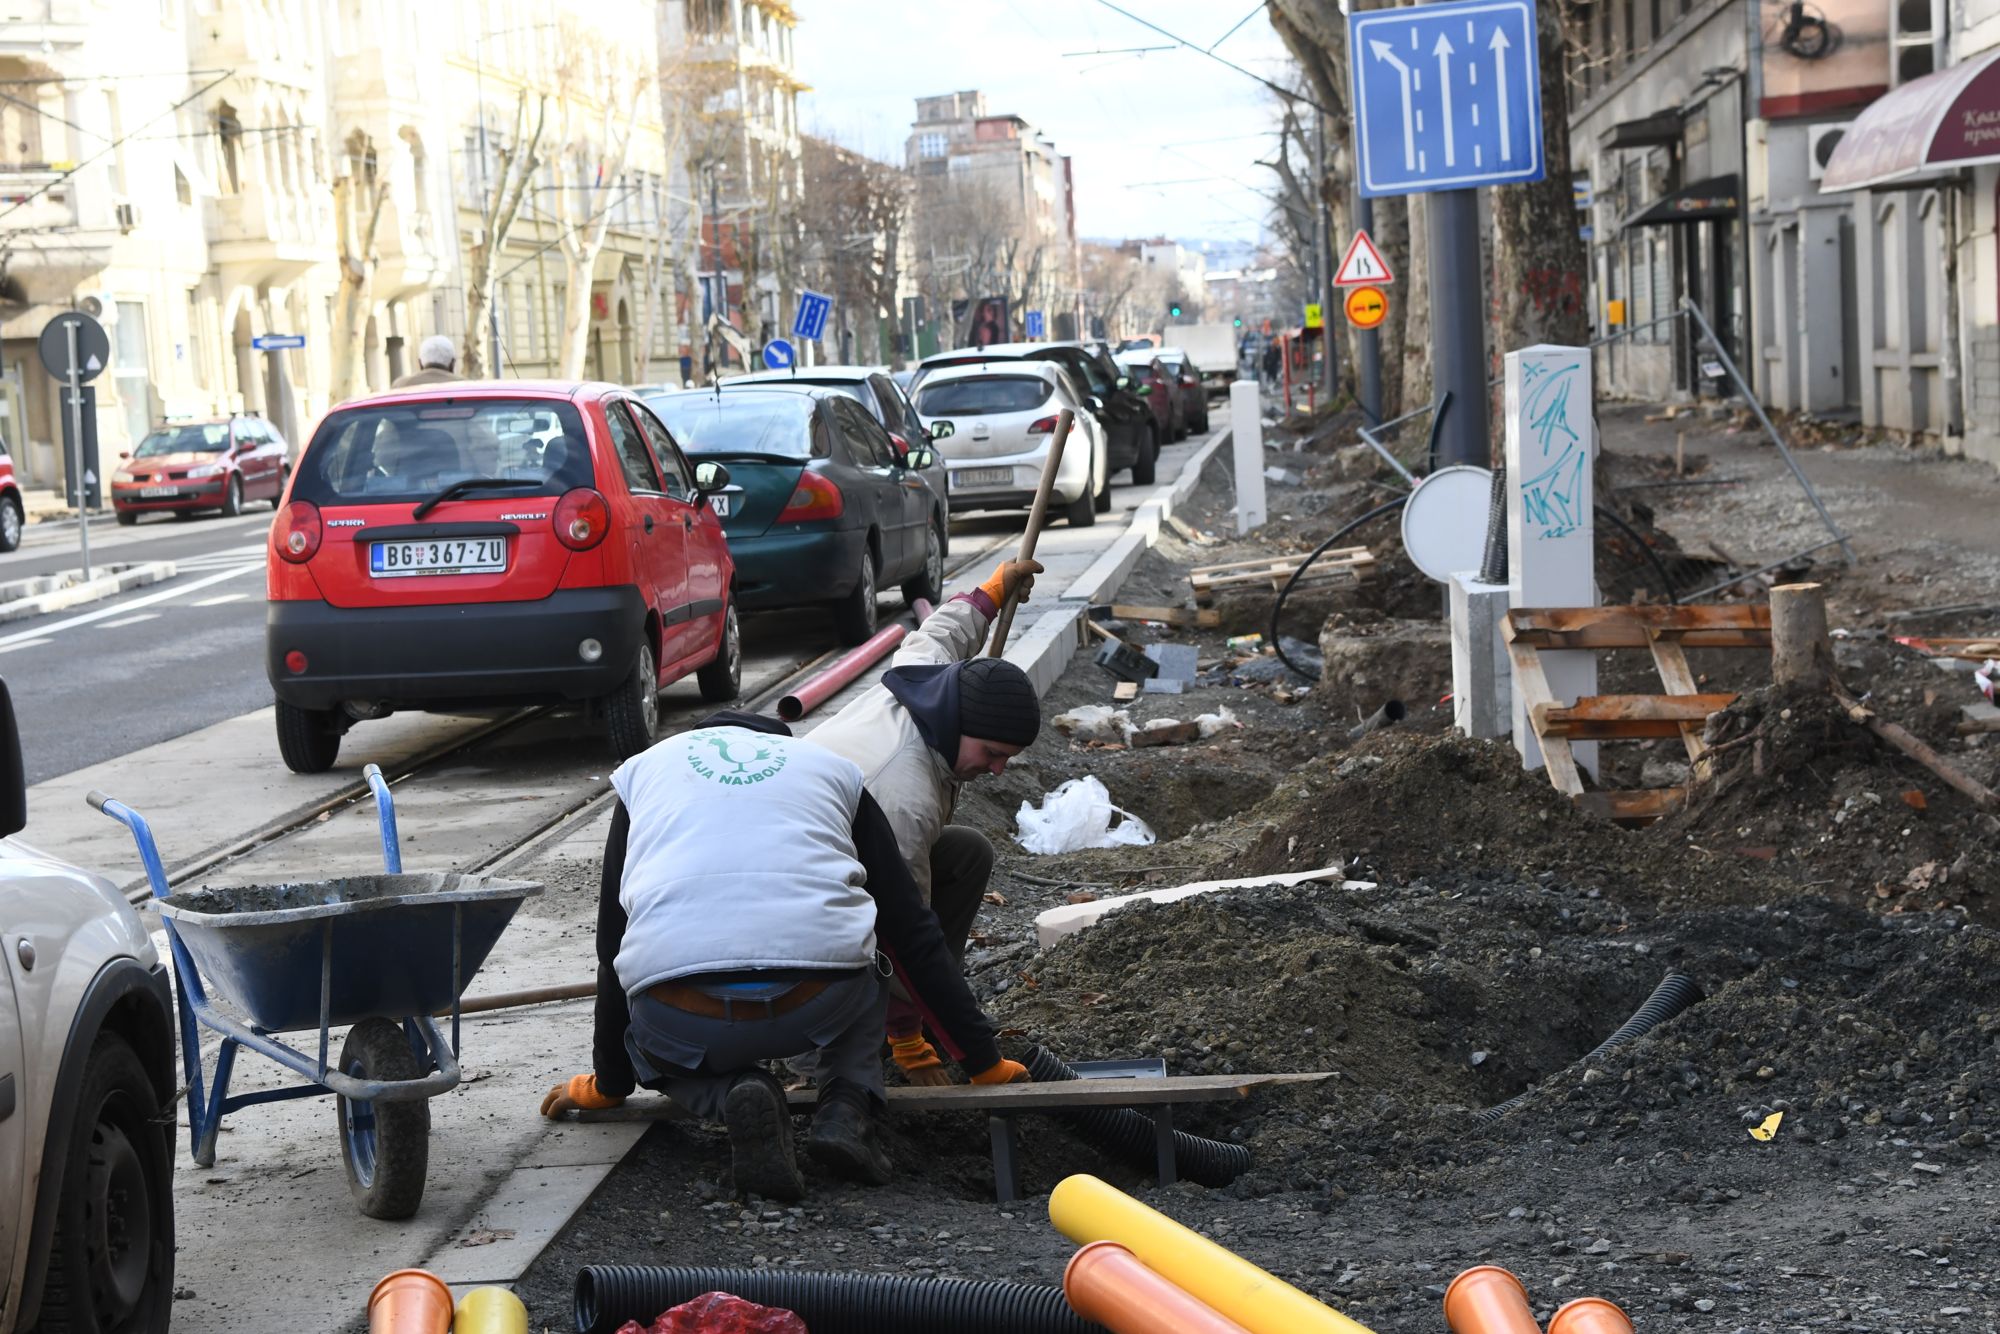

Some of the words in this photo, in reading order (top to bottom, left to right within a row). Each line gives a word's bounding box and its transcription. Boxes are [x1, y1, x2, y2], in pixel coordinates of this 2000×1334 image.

[327, 519, 366, 527] SPARK
[387, 546, 413, 566] BG
[688, 755, 715, 779] JAJA
[718, 756, 787, 785] NAJBOLJA
